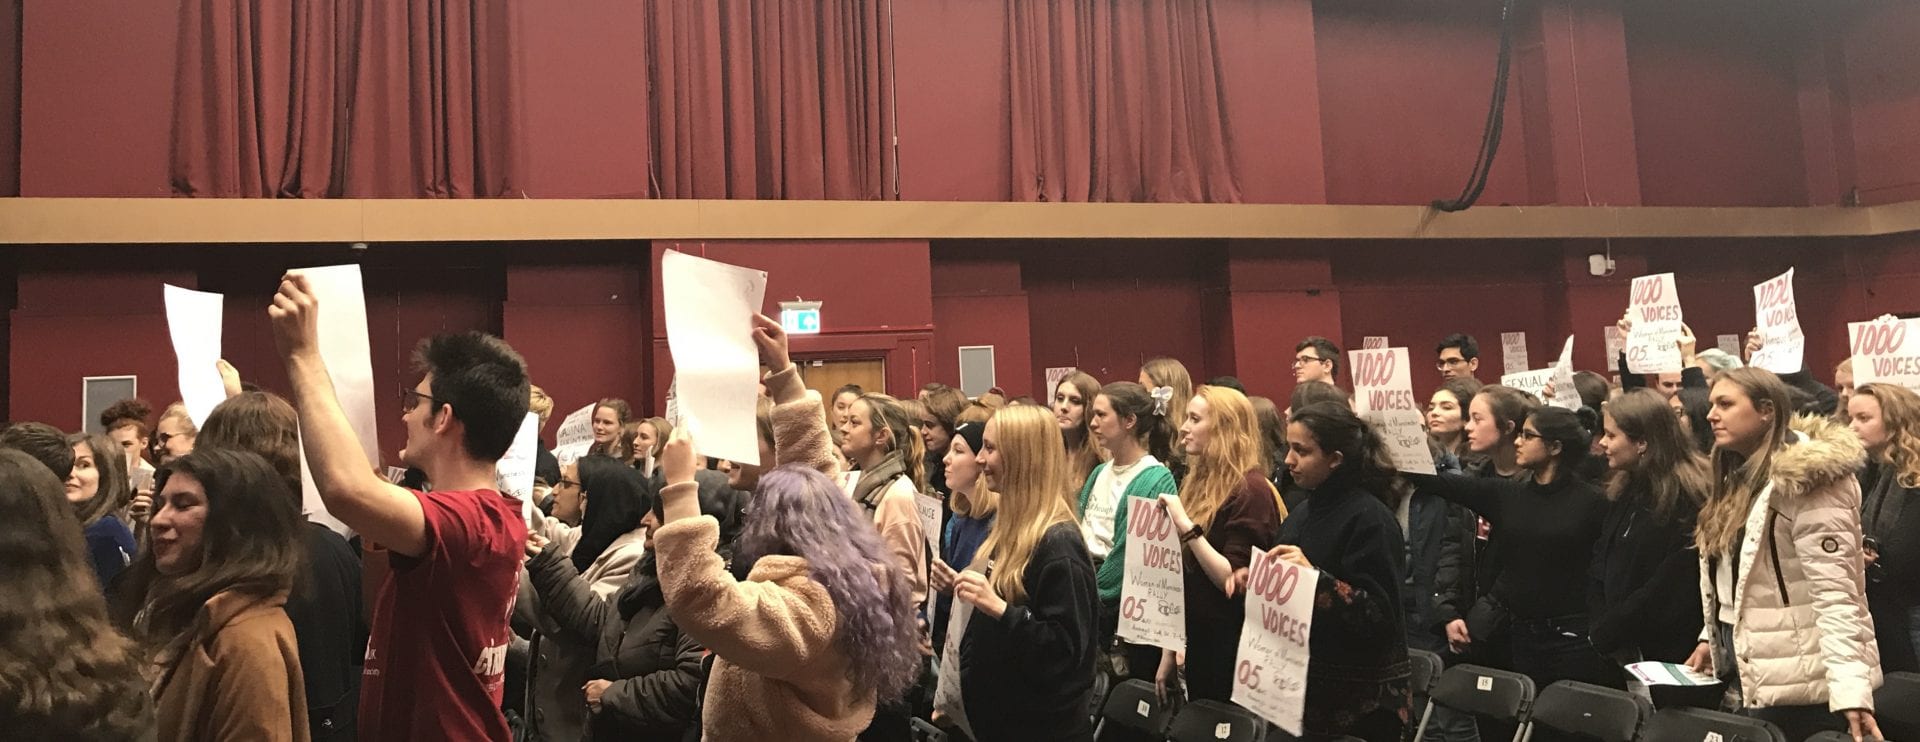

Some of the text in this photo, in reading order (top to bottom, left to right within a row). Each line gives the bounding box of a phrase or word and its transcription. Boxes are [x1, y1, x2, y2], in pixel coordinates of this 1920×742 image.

[1630, 276, 1662, 305] 1000
[1641, 304, 1679, 323] VOICES
[1363, 337, 1383, 349] 1000
[1852, 321, 1907, 355] 1000
[1354, 350, 1396, 387] 1000
[1504, 374, 1545, 389] SEXUAL
[1872, 356, 1920, 377] VOICES
[1368, 389, 1412, 411] VOICES
[1128, 499, 1172, 541] 1000
[1143, 542, 1181, 575] VOICES
[1247, 553, 1299, 606] 1000
[1122, 595, 1147, 621] 05
[1261, 603, 1307, 648] VOICES
[1237, 659, 1263, 690] 05
